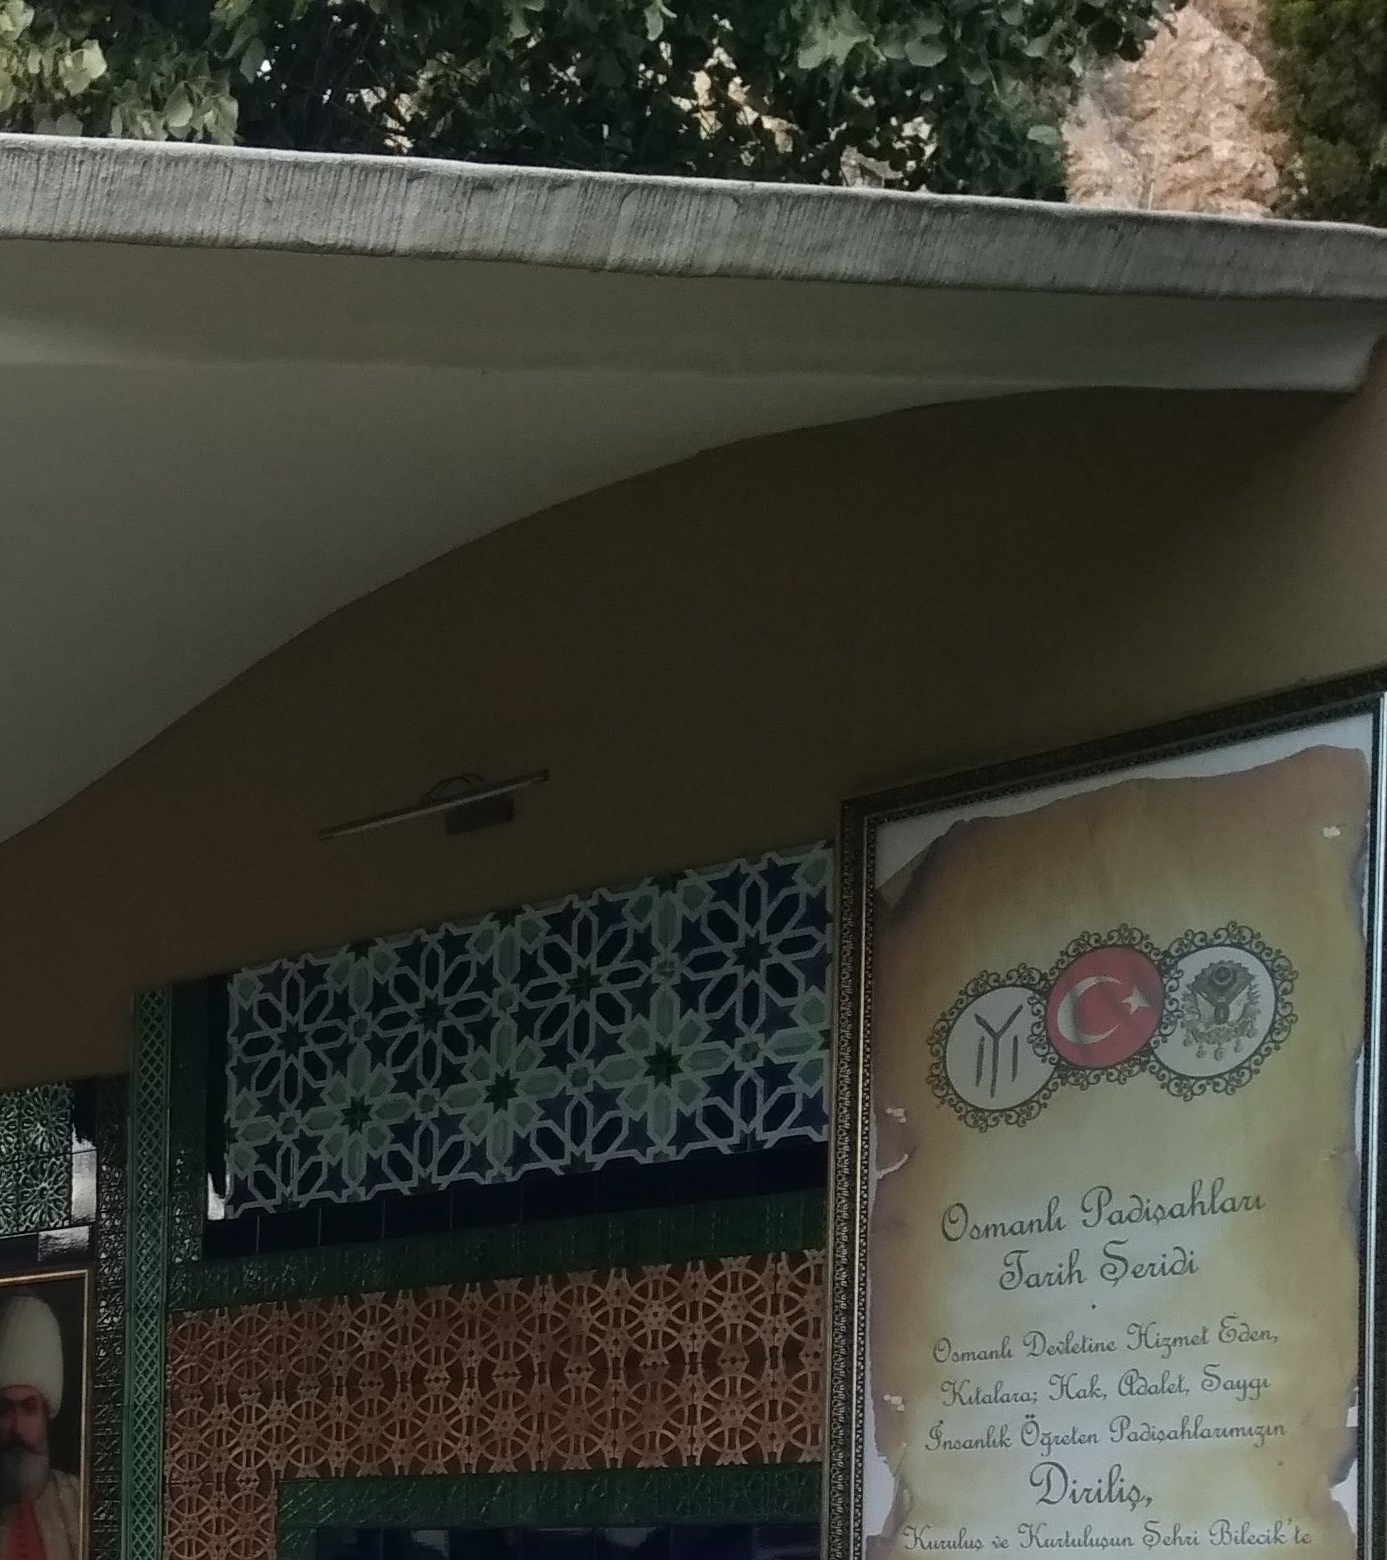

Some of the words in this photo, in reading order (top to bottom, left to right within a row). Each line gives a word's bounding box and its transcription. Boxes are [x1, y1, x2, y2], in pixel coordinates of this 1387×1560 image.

[941, 1196, 1067, 1242] Osmanlı
[1081, 1177, 1266, 1228] Padişahları
[999, 1248, 1087, 1290] Tarih
[1099, 1239, 1199, 1287] Şeridi
[932, 1335, 1014, 1363] Osmanlı
[1022, 1330, 1117, 1358] Devletine
[1126, 1321, 1210, 1359] Hizmet
[1048, 1372, 1107, 1401] Hak,
[1200, 1363, 1271, 1402] Saygı
[925, 1419, 1013, 1451] İnsanlık
[1020, 1413, 1100, 1457] Öğreten
[1108, 1414, 1287, 1449] Padişahlarımızın
[1029, 1461, 1154, 1512] Diriliş,
[903, 1524, 985, 1550] Kuruluş
[992, 1534, 1010, 1549] ve
[1017, 1523, 1135, 1551] Kurtuluşun
[1141, 1520, 1201, 1551] Şehri
